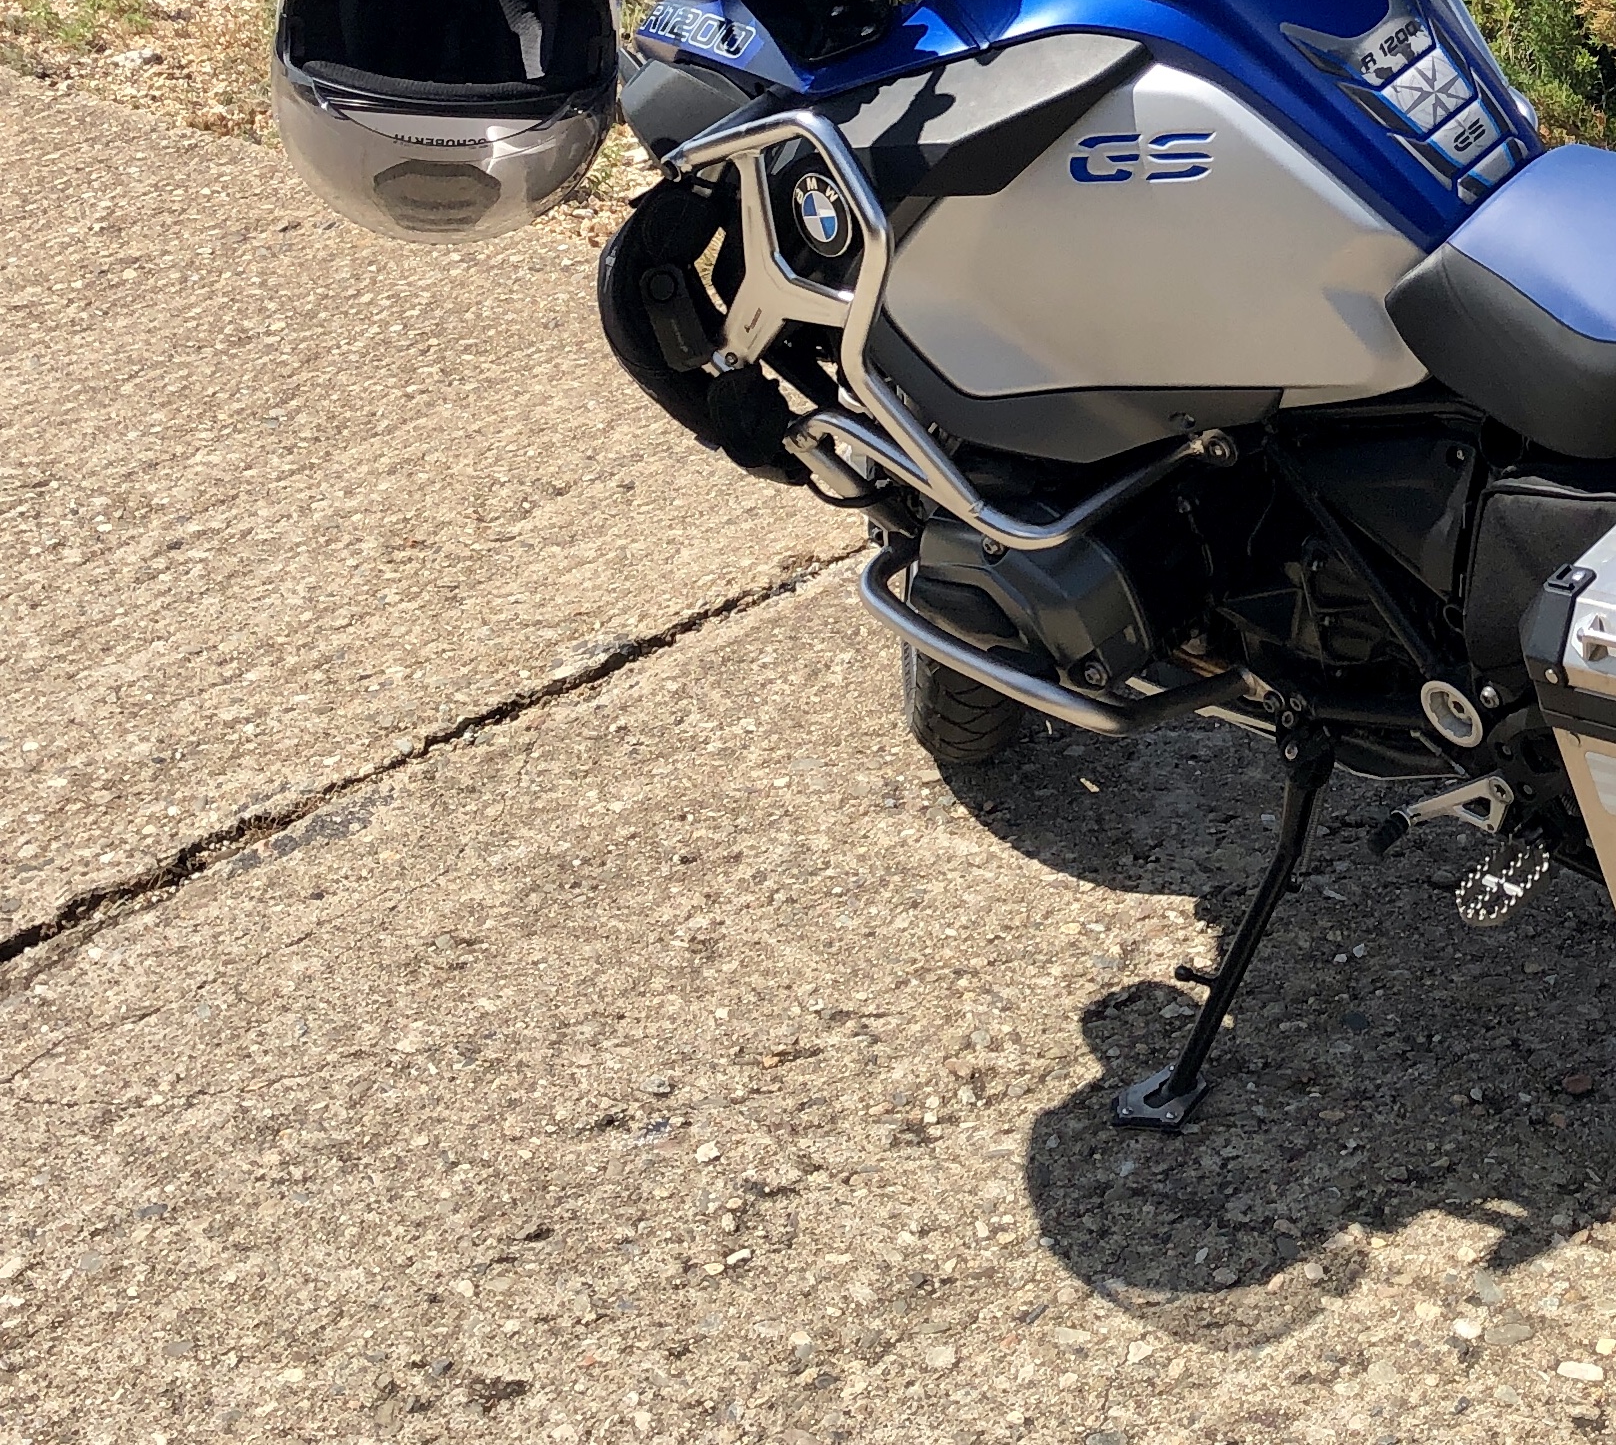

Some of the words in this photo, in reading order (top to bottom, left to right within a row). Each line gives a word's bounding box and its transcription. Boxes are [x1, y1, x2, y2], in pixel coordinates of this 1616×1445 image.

[640, 2, 757, 59] R1200
[1360, 51, 1377, 72] R
[1453, 117, 1486, 152] GS
[1069, 132, 1216, 183] GS
[795, 176, 839, 204] BMW
